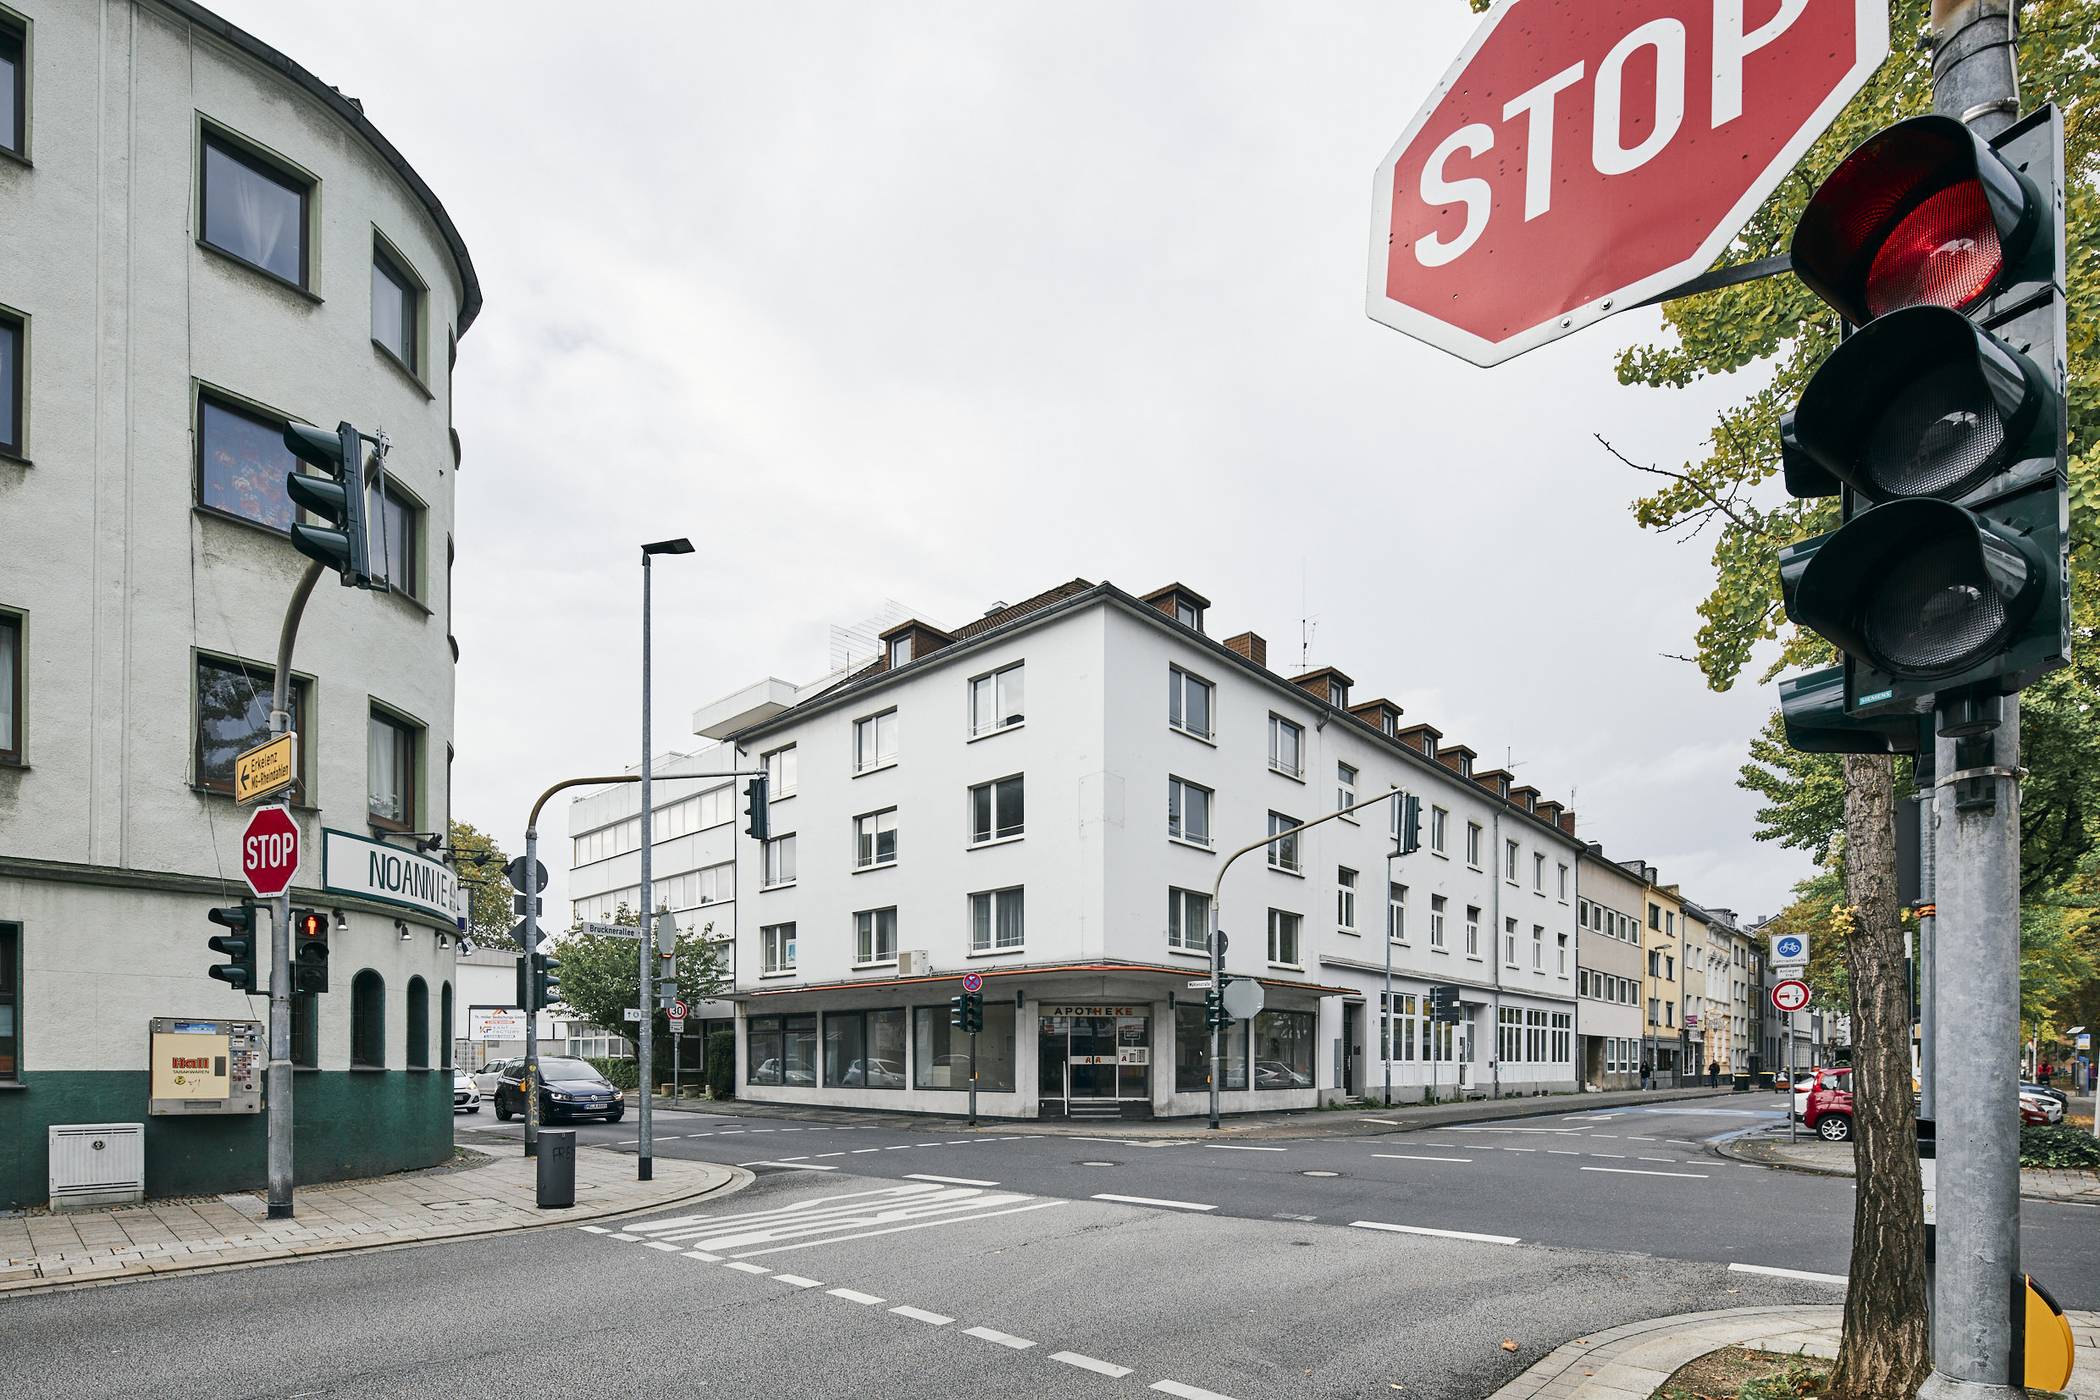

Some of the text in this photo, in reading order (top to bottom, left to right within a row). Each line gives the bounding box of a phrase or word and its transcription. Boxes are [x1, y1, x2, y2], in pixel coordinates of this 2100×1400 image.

[1415, 0, 1803, 267] STOP
[251, 751, 278, 773] Erkelenz
[251, 764, 289, 790] MG-Rheindahlen
[246, 832, 294, 870] STOP
[589, 924, 635, 937] Brucknerallee
[671, 1006, 682, 1015] 30
[1054, 1007, 1133, 1016] APOTHEKE
